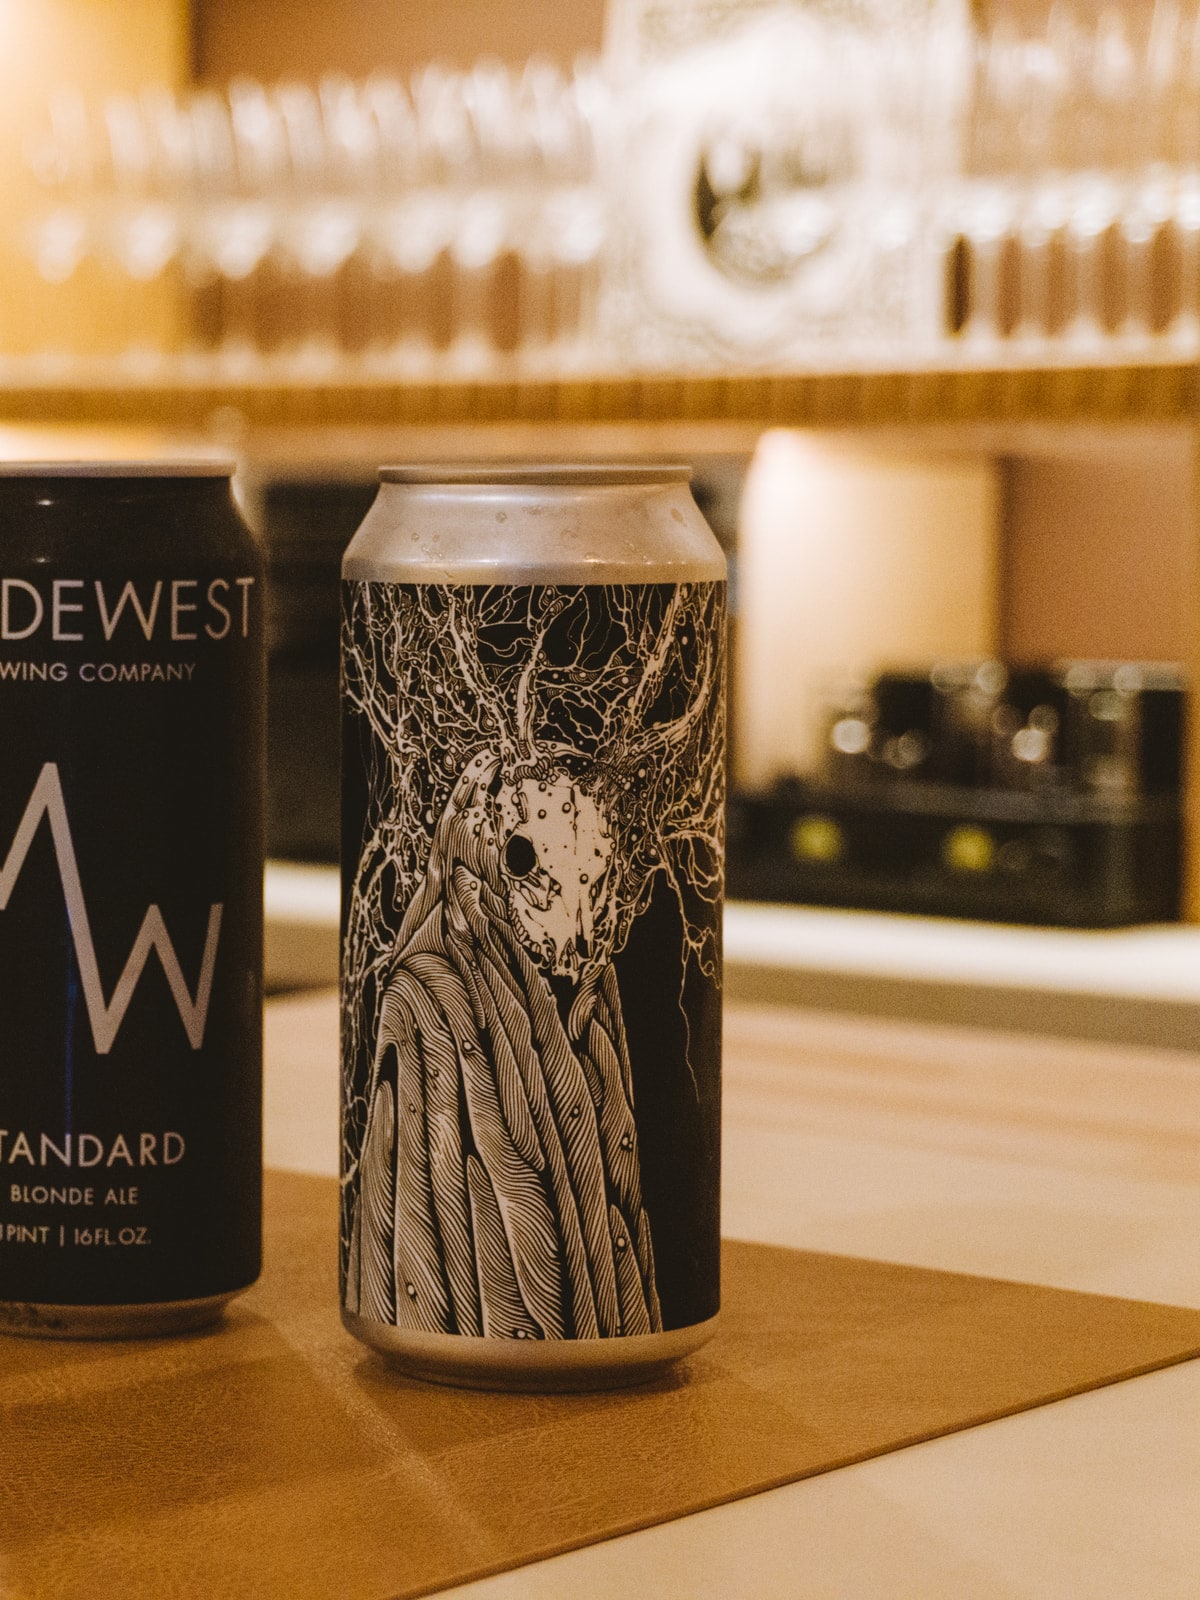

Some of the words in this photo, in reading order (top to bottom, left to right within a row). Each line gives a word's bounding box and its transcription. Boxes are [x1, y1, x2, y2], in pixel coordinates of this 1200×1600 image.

[79, 662, 196, 683] COMPANY
[10, 1184, 94, 1205] BLONDE
[104, 1187, 139, 1205] ALE
